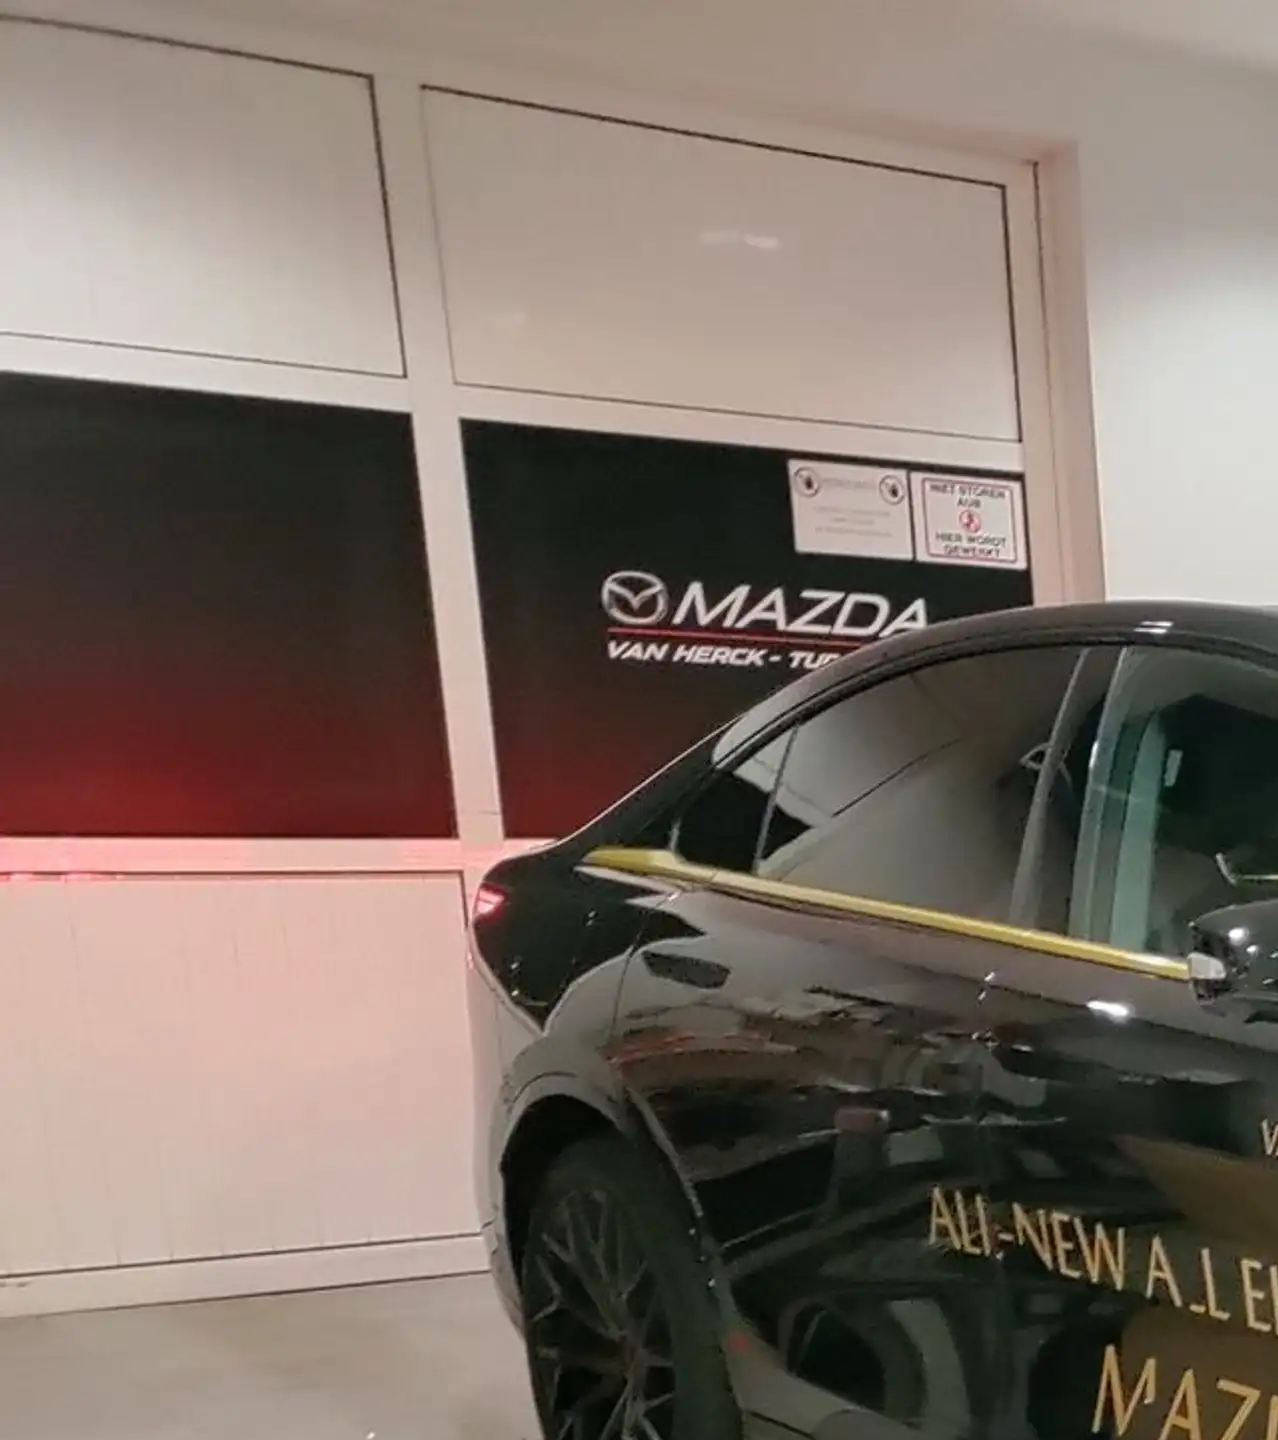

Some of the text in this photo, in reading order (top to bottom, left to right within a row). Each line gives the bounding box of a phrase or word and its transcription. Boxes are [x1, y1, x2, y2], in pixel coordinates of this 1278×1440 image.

[672, 581, 929, 637] MAZDA
[607, 640, 668, 662] VAN
[672, 644, 769, 668] HERCK
